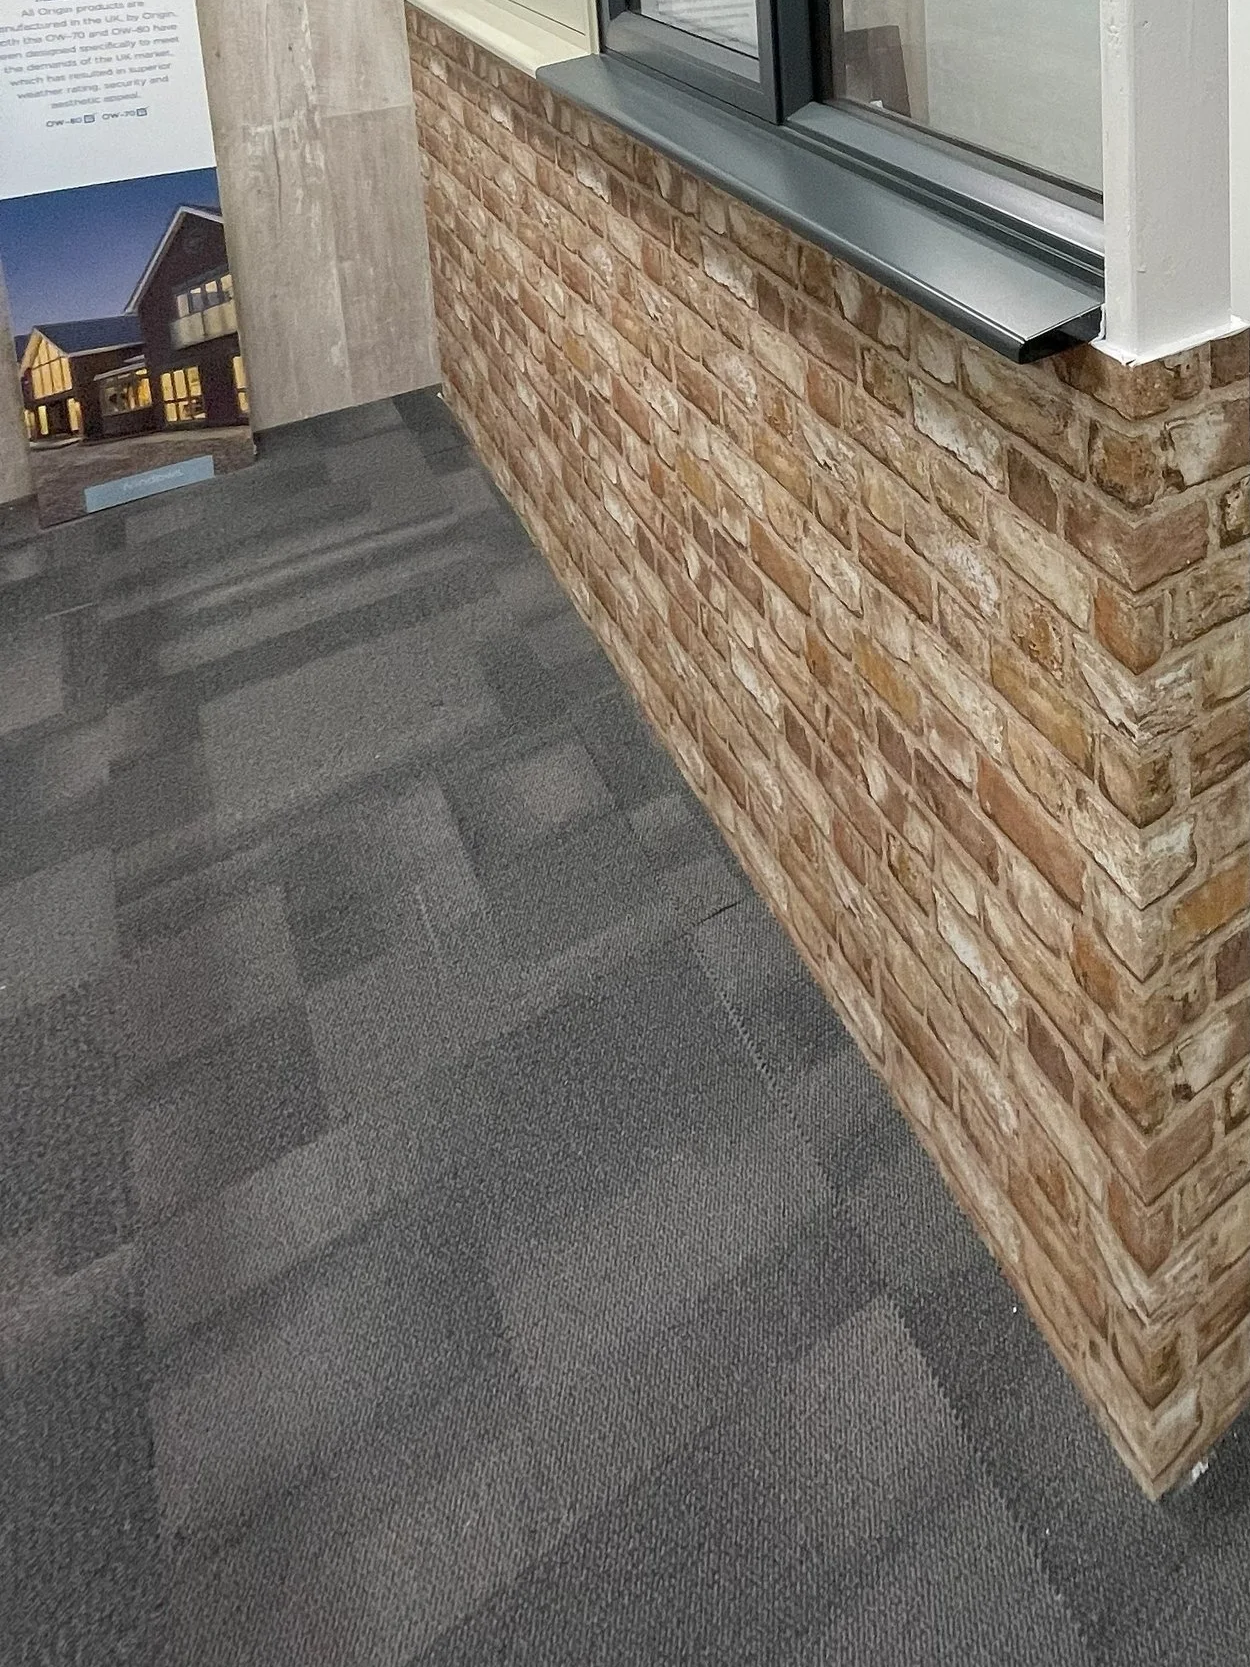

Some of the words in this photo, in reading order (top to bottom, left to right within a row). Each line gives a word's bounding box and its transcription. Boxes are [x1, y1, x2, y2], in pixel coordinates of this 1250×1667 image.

[21, 8, 35, 18] All
[38, 6, 73, 16] Origin
[76, 2, 125, 14] products
[83, 17, 101, 25] the
[126, 13, 139, 22] by
[23, 36, 42, 45] the
[45, 30, 85, 42] OW-70
[89, 29, 109, 38] and
[112, 25, 150, 35] OW-80
[153, 24, 178, 32] have
[25, 45, 76, 58] designed
[79, 40, 136, 52] specifically
[139, 38, 151, 46] to
[153, 36, 179, 44] meet
[4, 65, 23, 74] the
[27, 60, 77, 71] demands
[80, 56, 92, 65] of
[95, 56, 112, 64] the
[116, 53, 132, 61] UK
[9, 76, 44, 86] which
[46, 74, 66, 82] has
[69, 68, 113, 80] resulted
[128, 62, 172, 74] superior
[17, 88, 63, 99] weather
[104, 77, 147, 89] security
[150, 74, 169, 84] and
[51, 96, 102, 109] aesthetic
